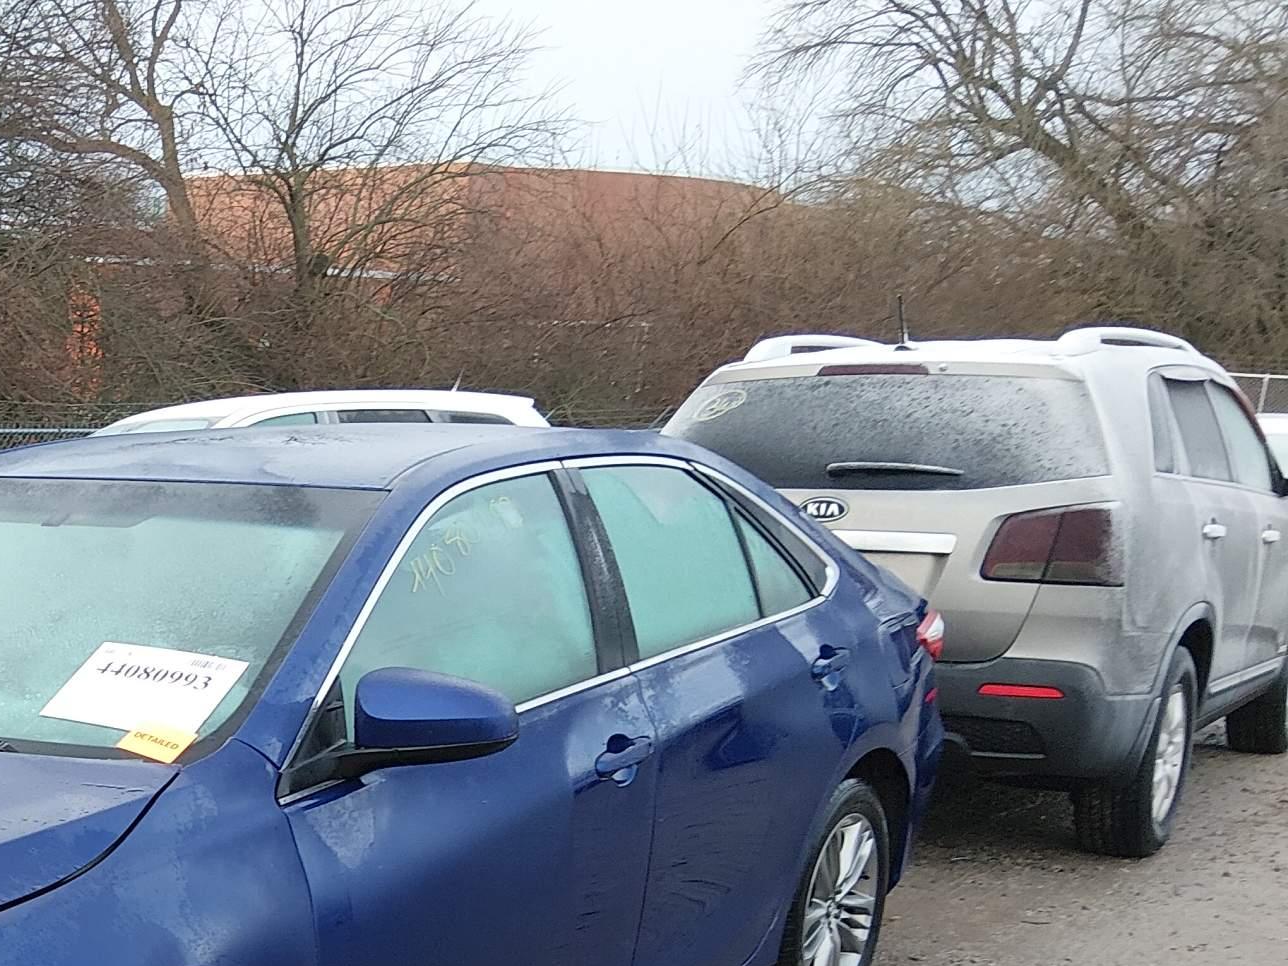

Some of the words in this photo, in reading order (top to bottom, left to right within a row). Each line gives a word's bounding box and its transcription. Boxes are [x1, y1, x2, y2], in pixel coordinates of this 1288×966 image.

[807, 502, 840, 517] KIA
[96, 661, 213, 690] 44080993
[133, 731, 180, 750] DETAILED
